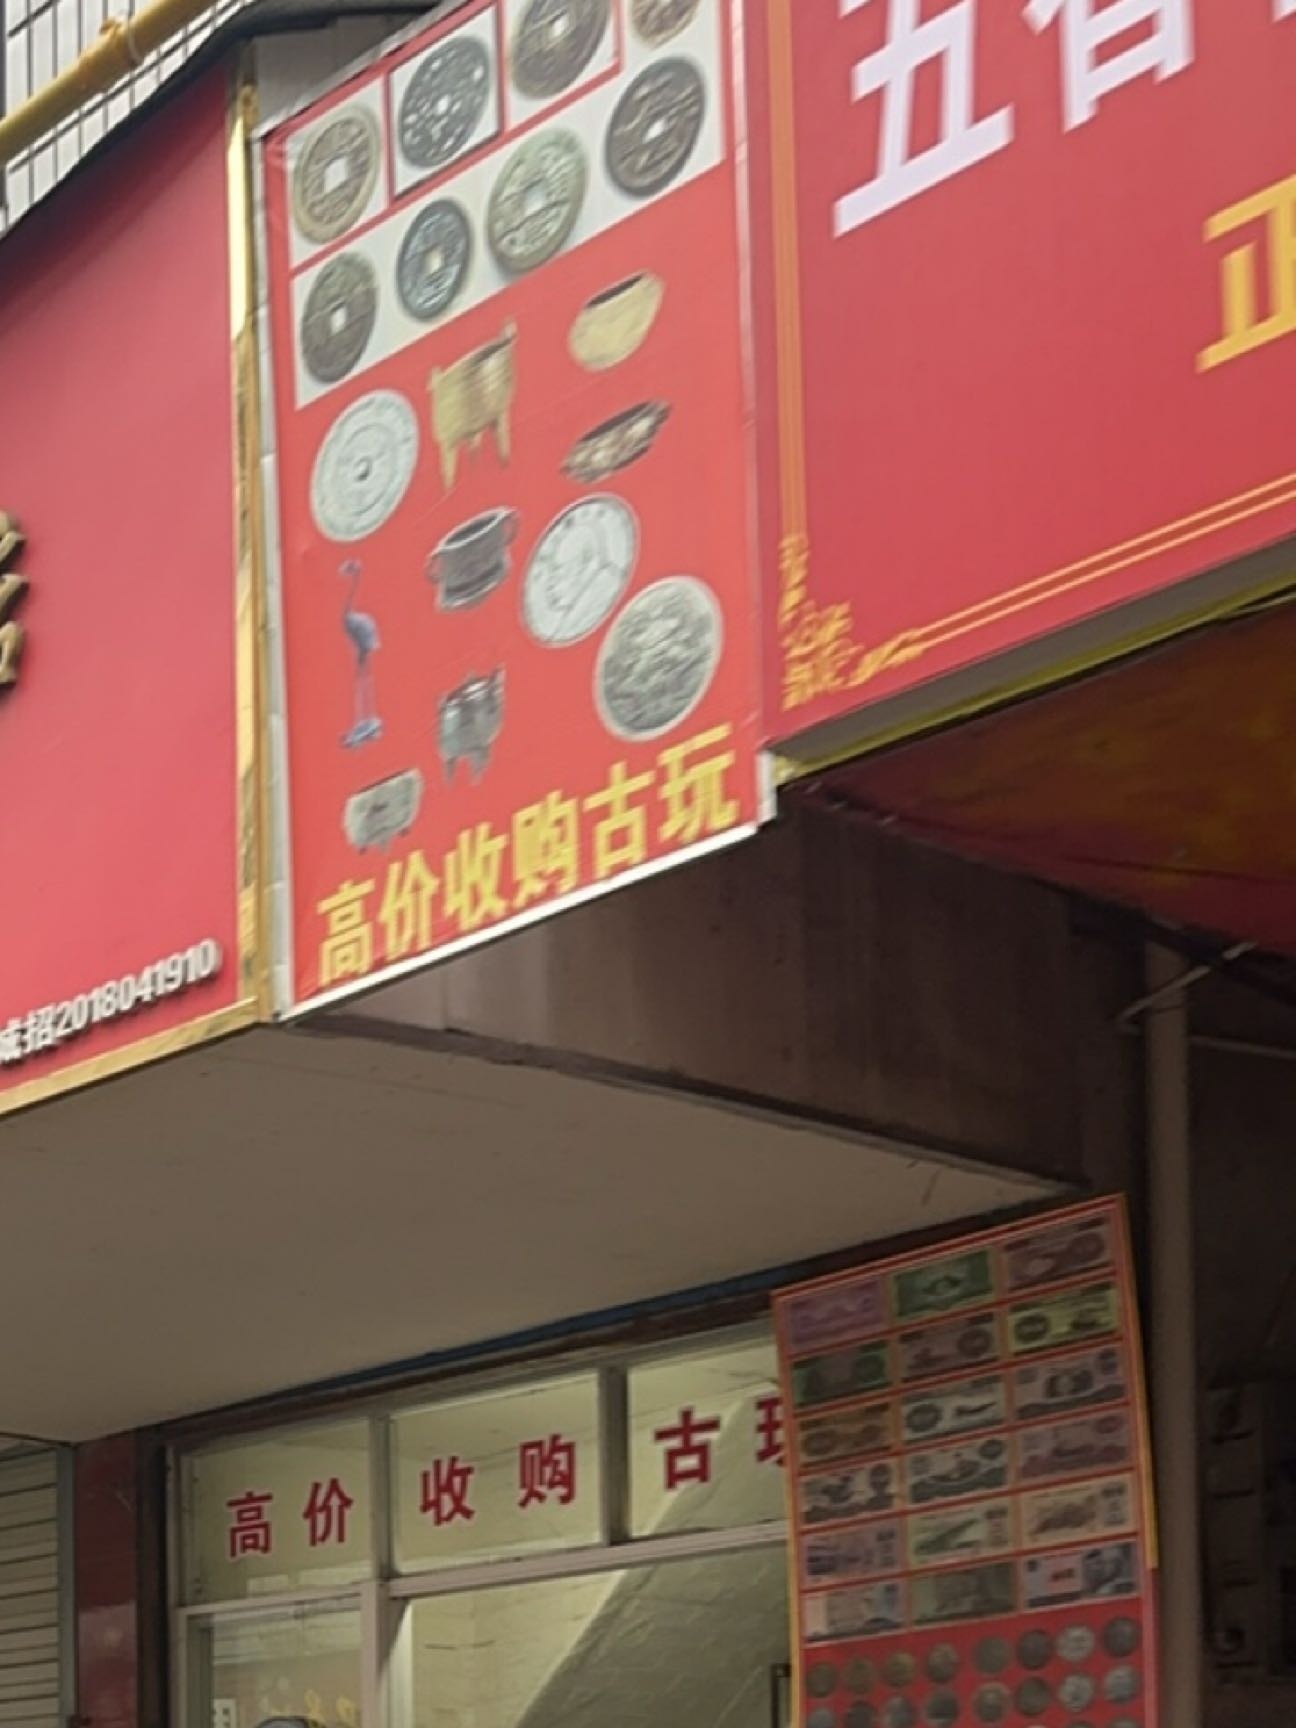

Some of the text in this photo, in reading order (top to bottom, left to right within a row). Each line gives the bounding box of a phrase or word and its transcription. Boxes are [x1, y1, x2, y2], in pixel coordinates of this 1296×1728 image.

[316, 724, 741, 990] 高价收购古玩
